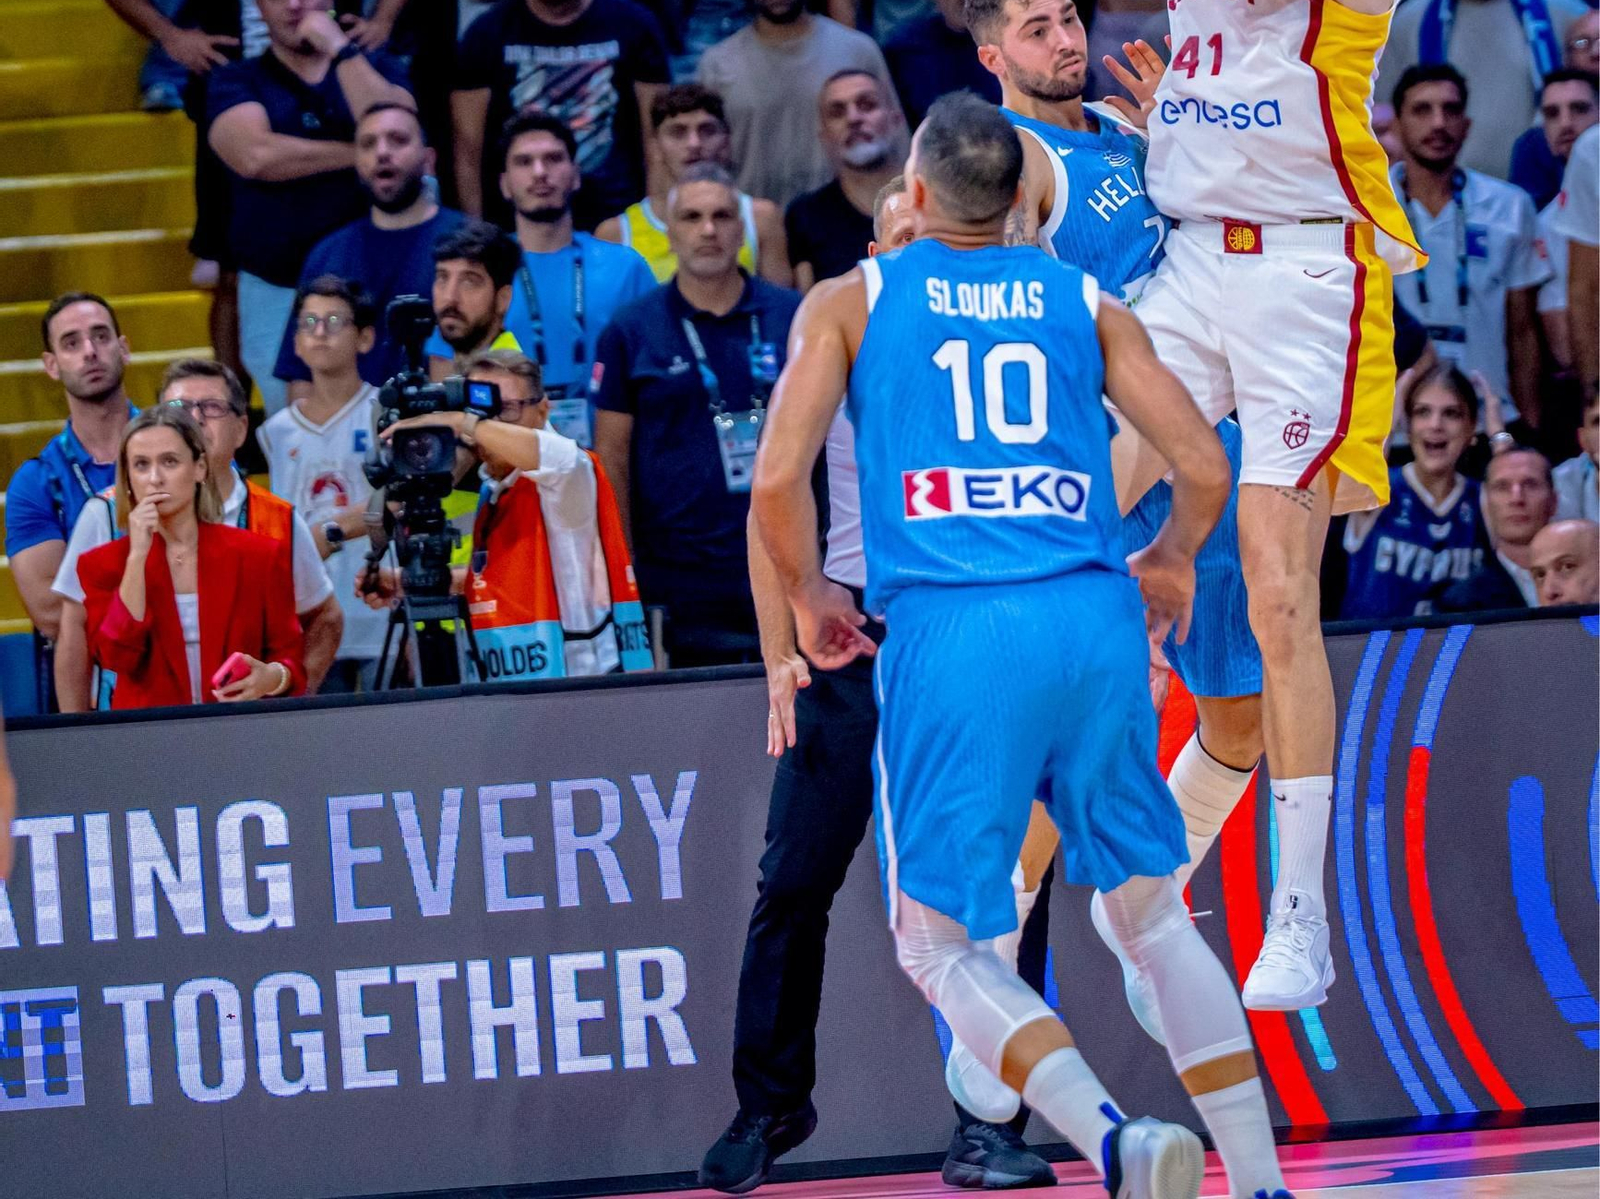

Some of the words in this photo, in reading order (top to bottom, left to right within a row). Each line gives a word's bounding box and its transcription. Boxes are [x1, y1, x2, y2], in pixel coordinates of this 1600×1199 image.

[1172, 32, 1223, 79] 41
[926, 277, 1044, 321] SLOUKAS
[931, 339, 1049, 444] 10
[964, 471, 1086, 514] EKO
[327, 771, 698, 923] EVERY
[103, 946, 697, 1106] TOGETHER
